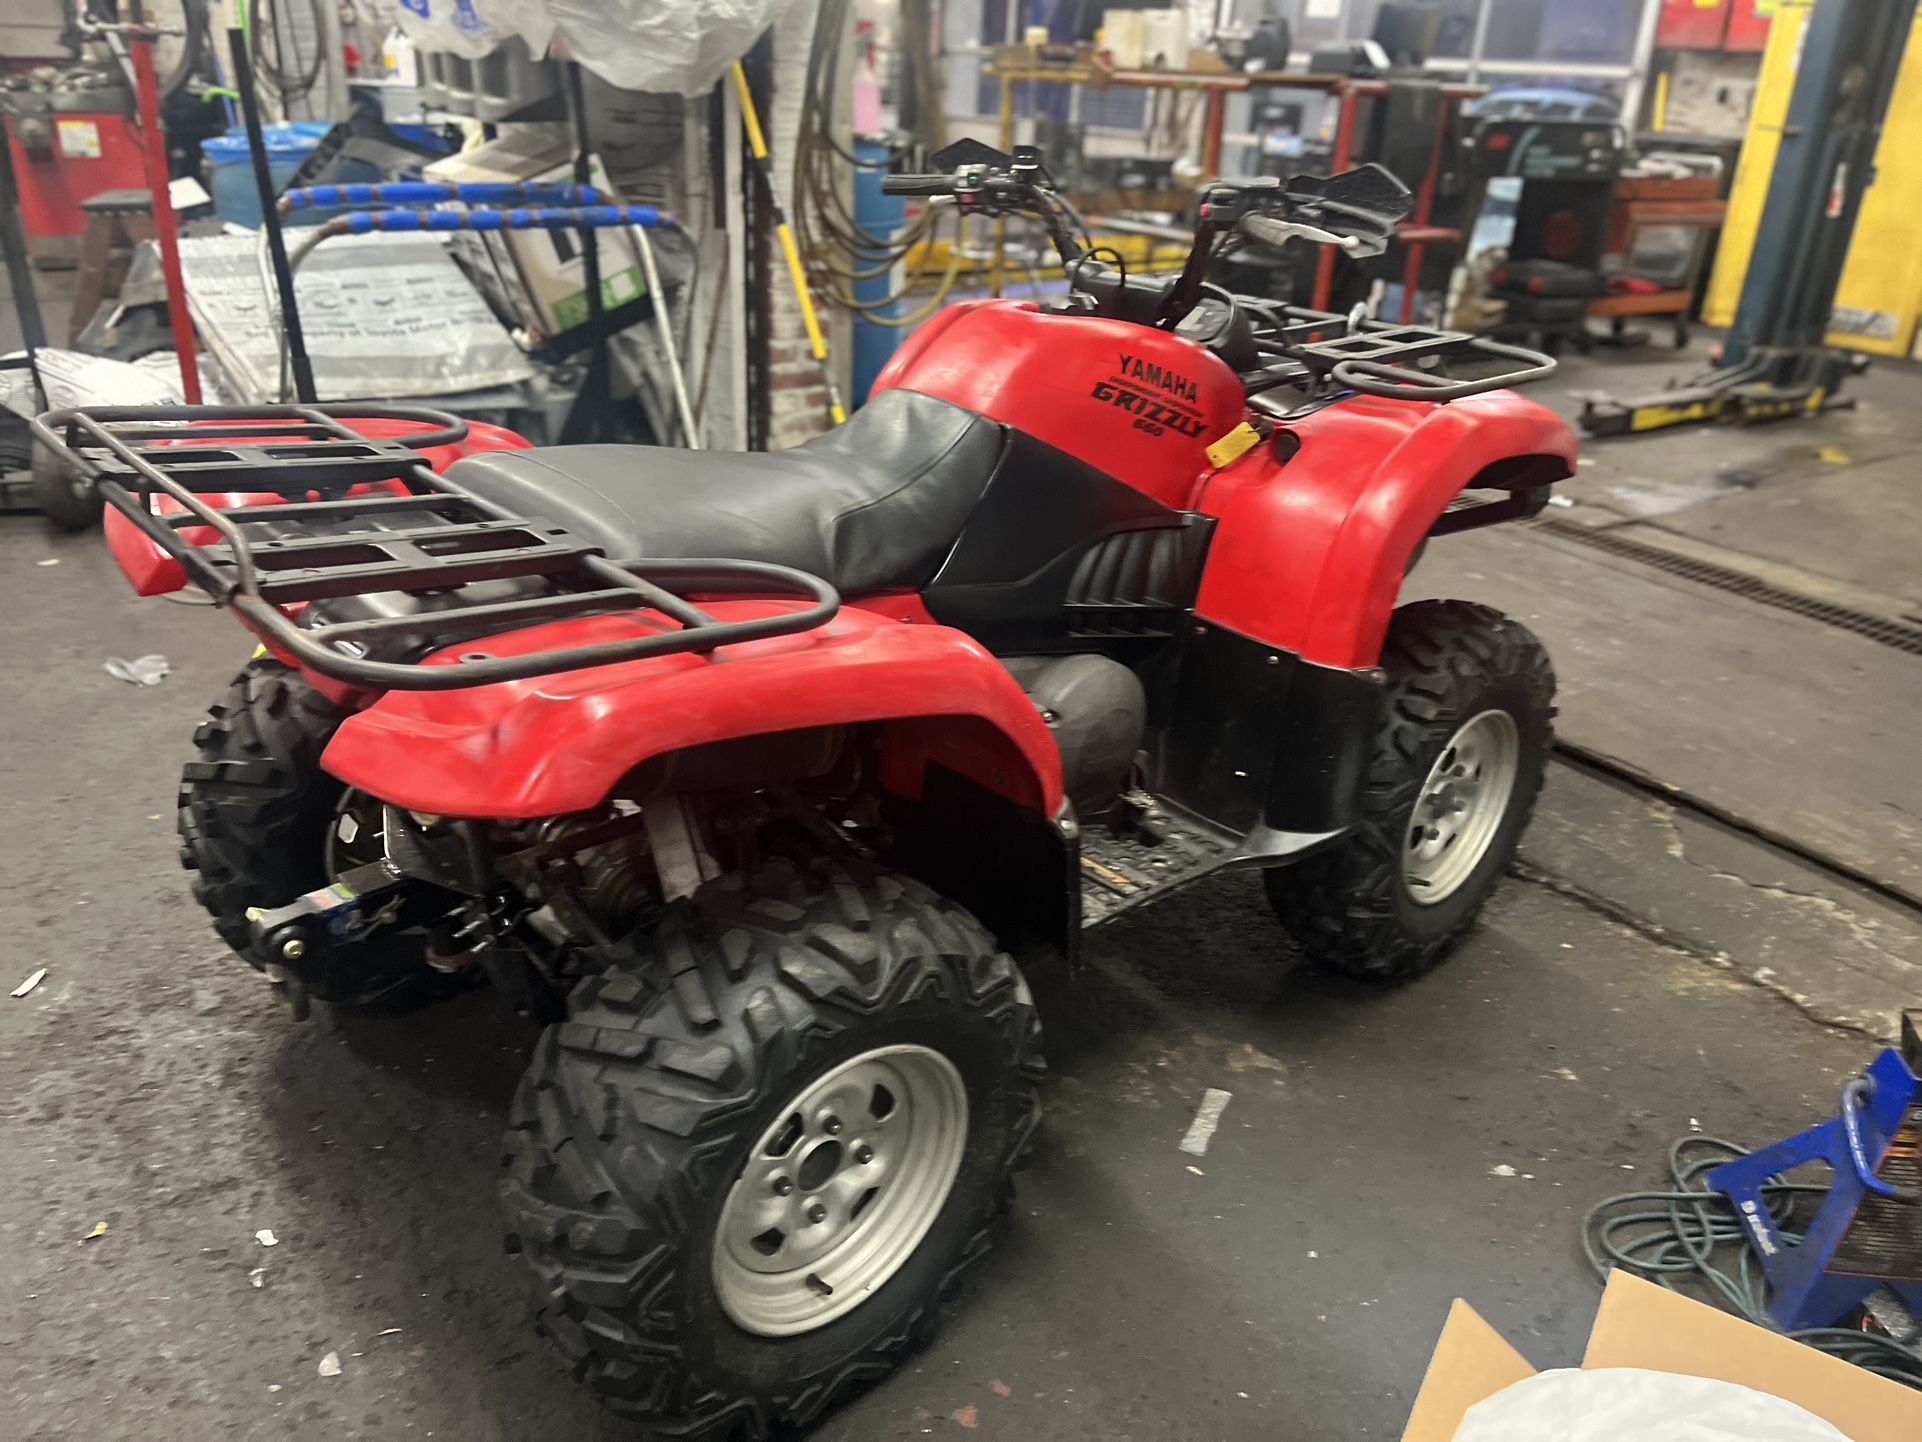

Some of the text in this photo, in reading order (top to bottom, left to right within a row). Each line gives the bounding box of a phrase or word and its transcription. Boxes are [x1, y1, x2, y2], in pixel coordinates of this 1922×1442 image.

[1119, 353, 1198, 403] YAMAHA
[1091, 381, 1209, 438] GRIZZLY
[1132, 418, 1165, 437] 660
